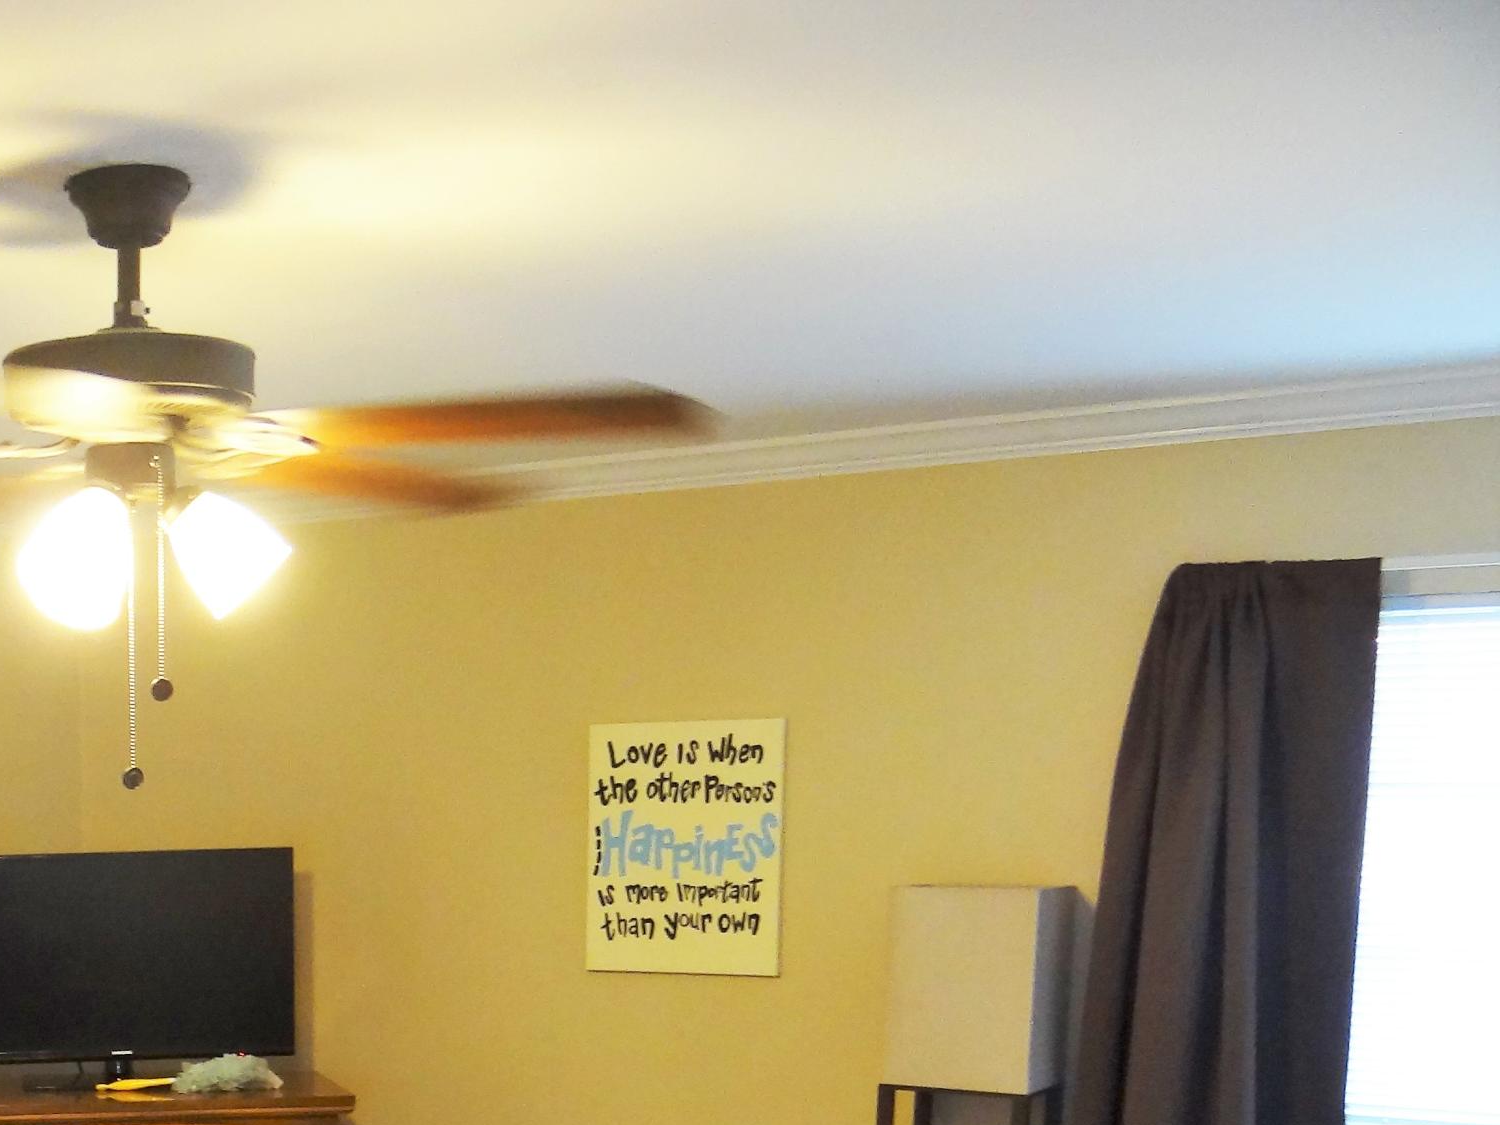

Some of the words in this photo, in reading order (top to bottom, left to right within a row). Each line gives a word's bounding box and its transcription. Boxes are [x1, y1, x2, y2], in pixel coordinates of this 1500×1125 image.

[607, 741, 668, 768] Love
[594, 775, 638, 806] the
[647, 772, 701, 803] other
[625, 883, 669, 904] more
[601, 912, 655, 941] than
[664, 912, 712, 940] your
[718, 912, 760, 935] own
